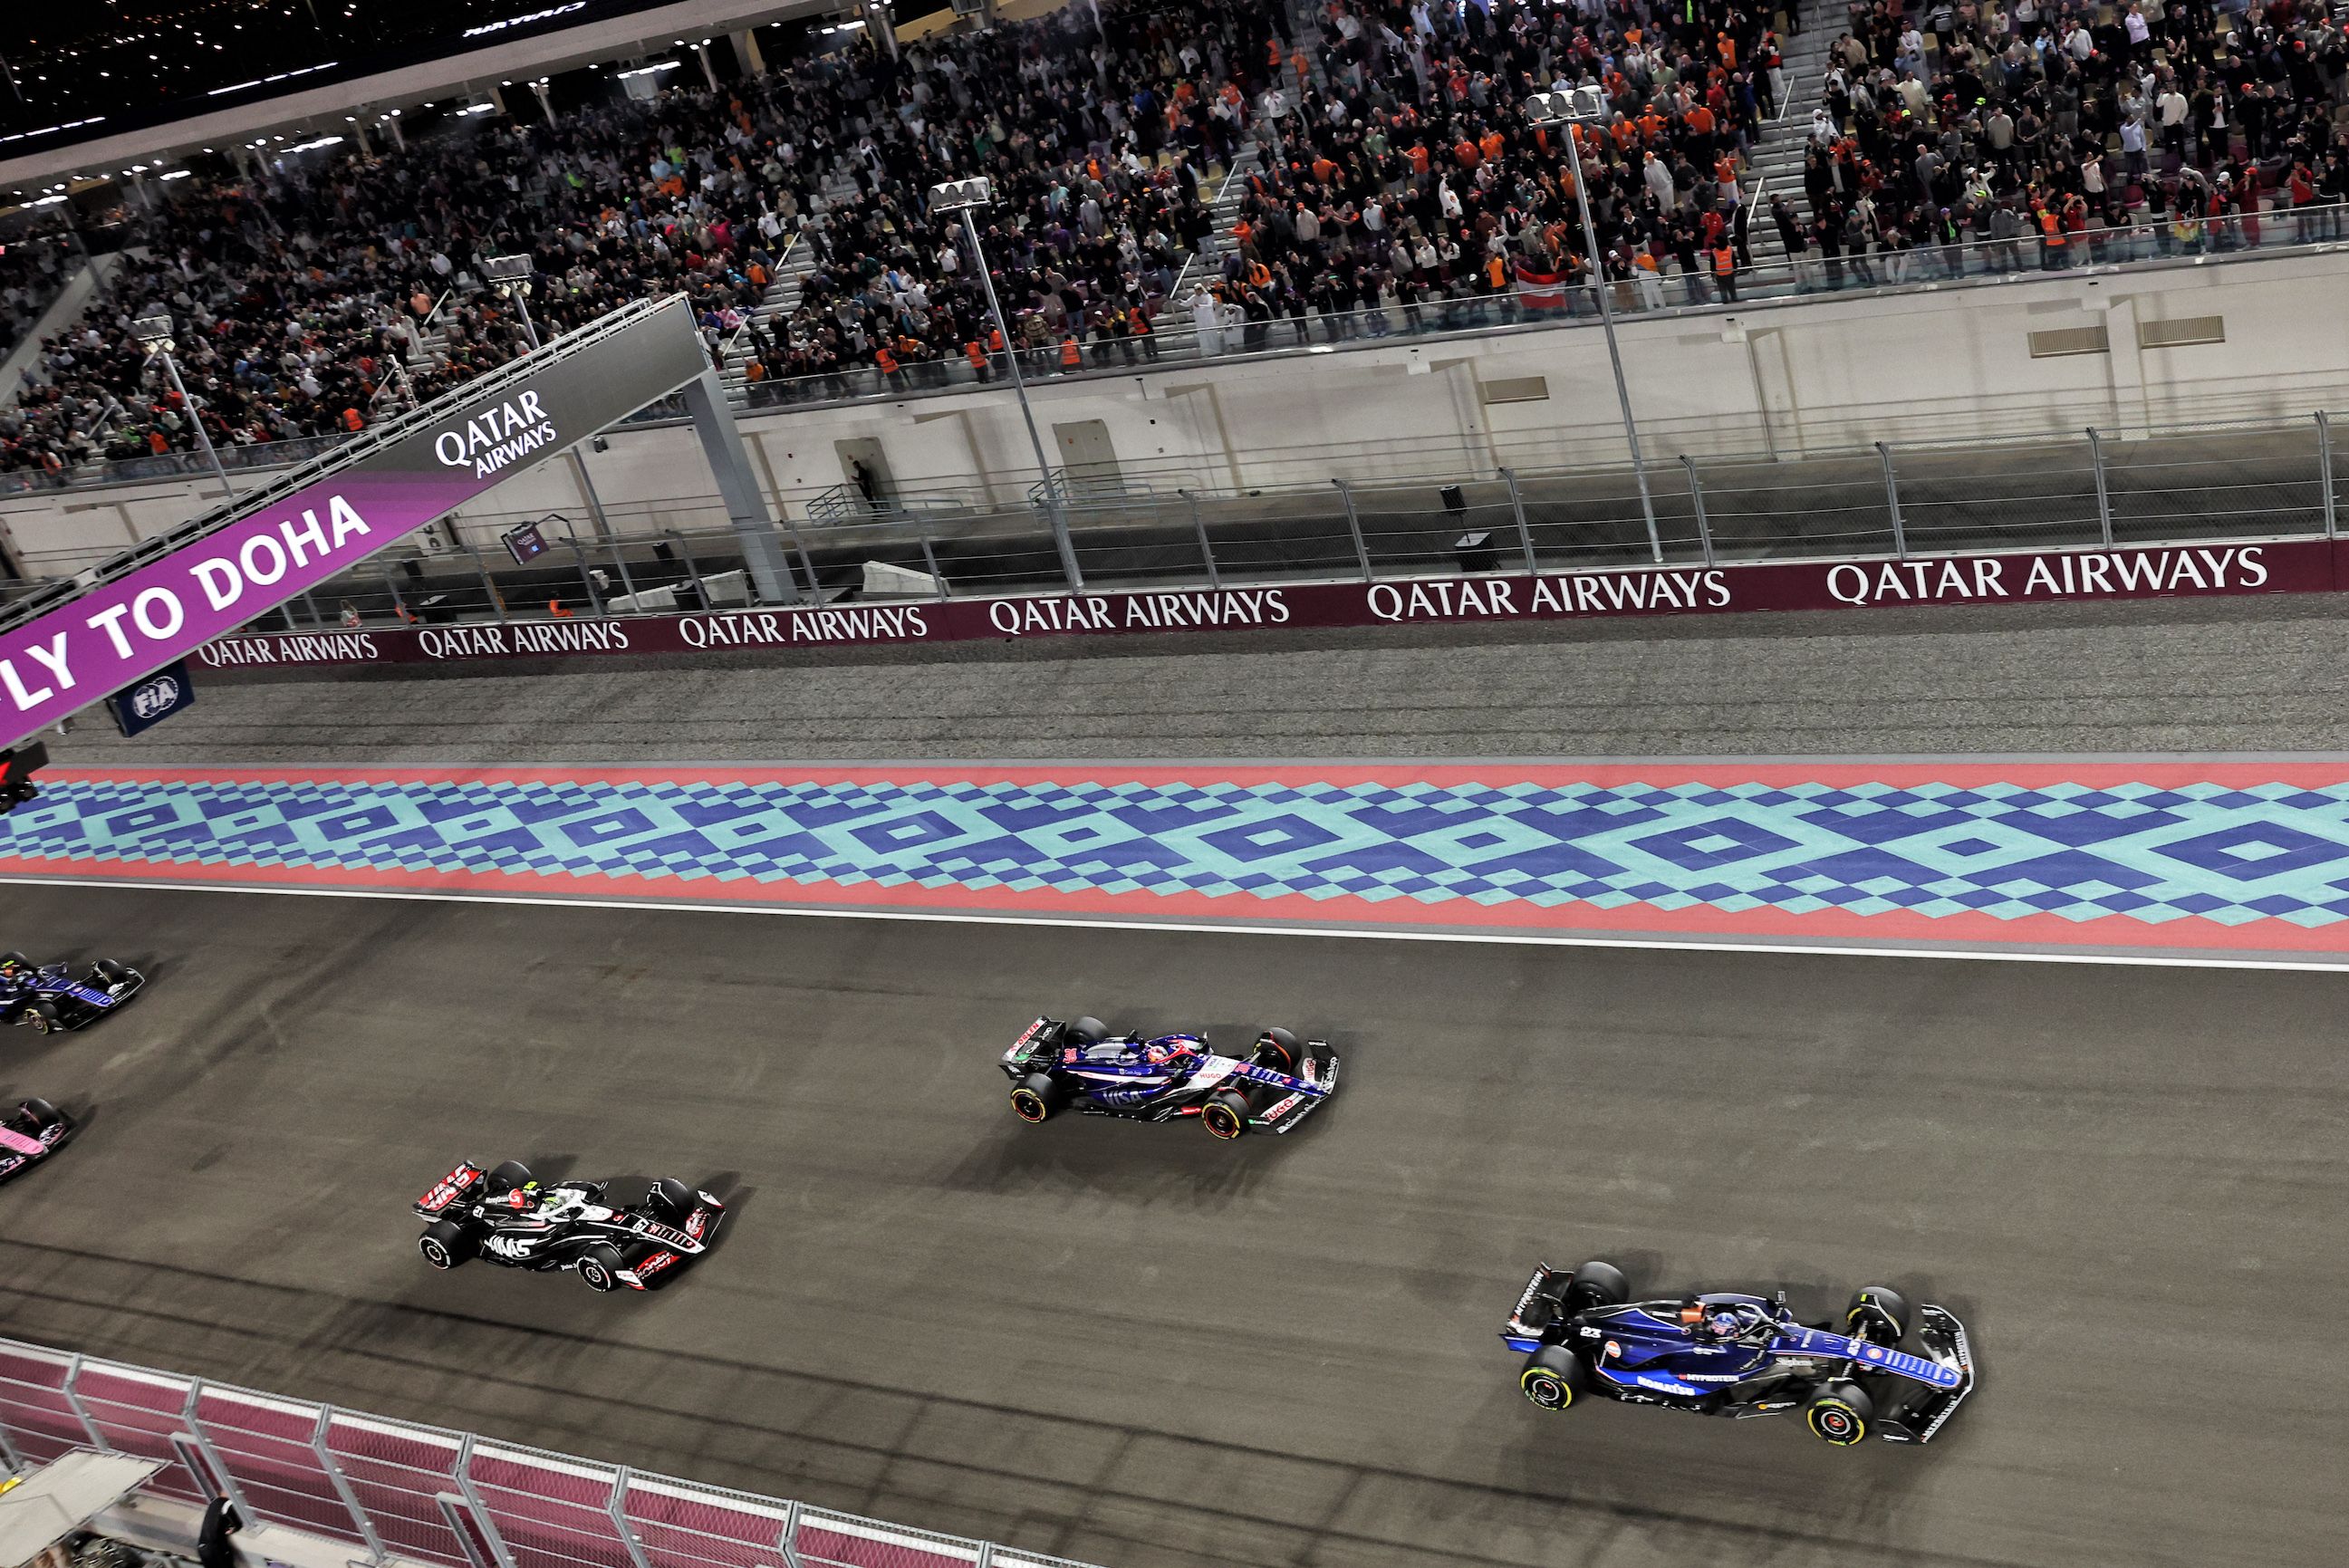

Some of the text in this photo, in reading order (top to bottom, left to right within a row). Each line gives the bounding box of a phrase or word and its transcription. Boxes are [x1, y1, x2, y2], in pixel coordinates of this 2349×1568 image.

[434, 390, 548, 468] QATAR
[476, 419, 557, 479] AIRWAYS
[1367, 570, 1732, 622] QATAR AIRWAYS
[1824, 545, 2269, 606] QATAR AIRWAYS
[0, 495, 371, 712] LY TO DOHA
[989, 587, 1292, 636] QATAR AIRWAYS
[198, 633, 379, 668] QATAR AIRWAYS
[418, 620, 630, 659] QATAR AIRWAYS
[678, 606, 929, 649] QATAR AIRWAYS
[1018, 1023, 1040, 1045] ORLEN
[1102, 1090, 1143, 1107] VISA
[1515, 1270, 1545, 1316] MYPROTEIN
[1580, 1326, 1603, 1339] 23
